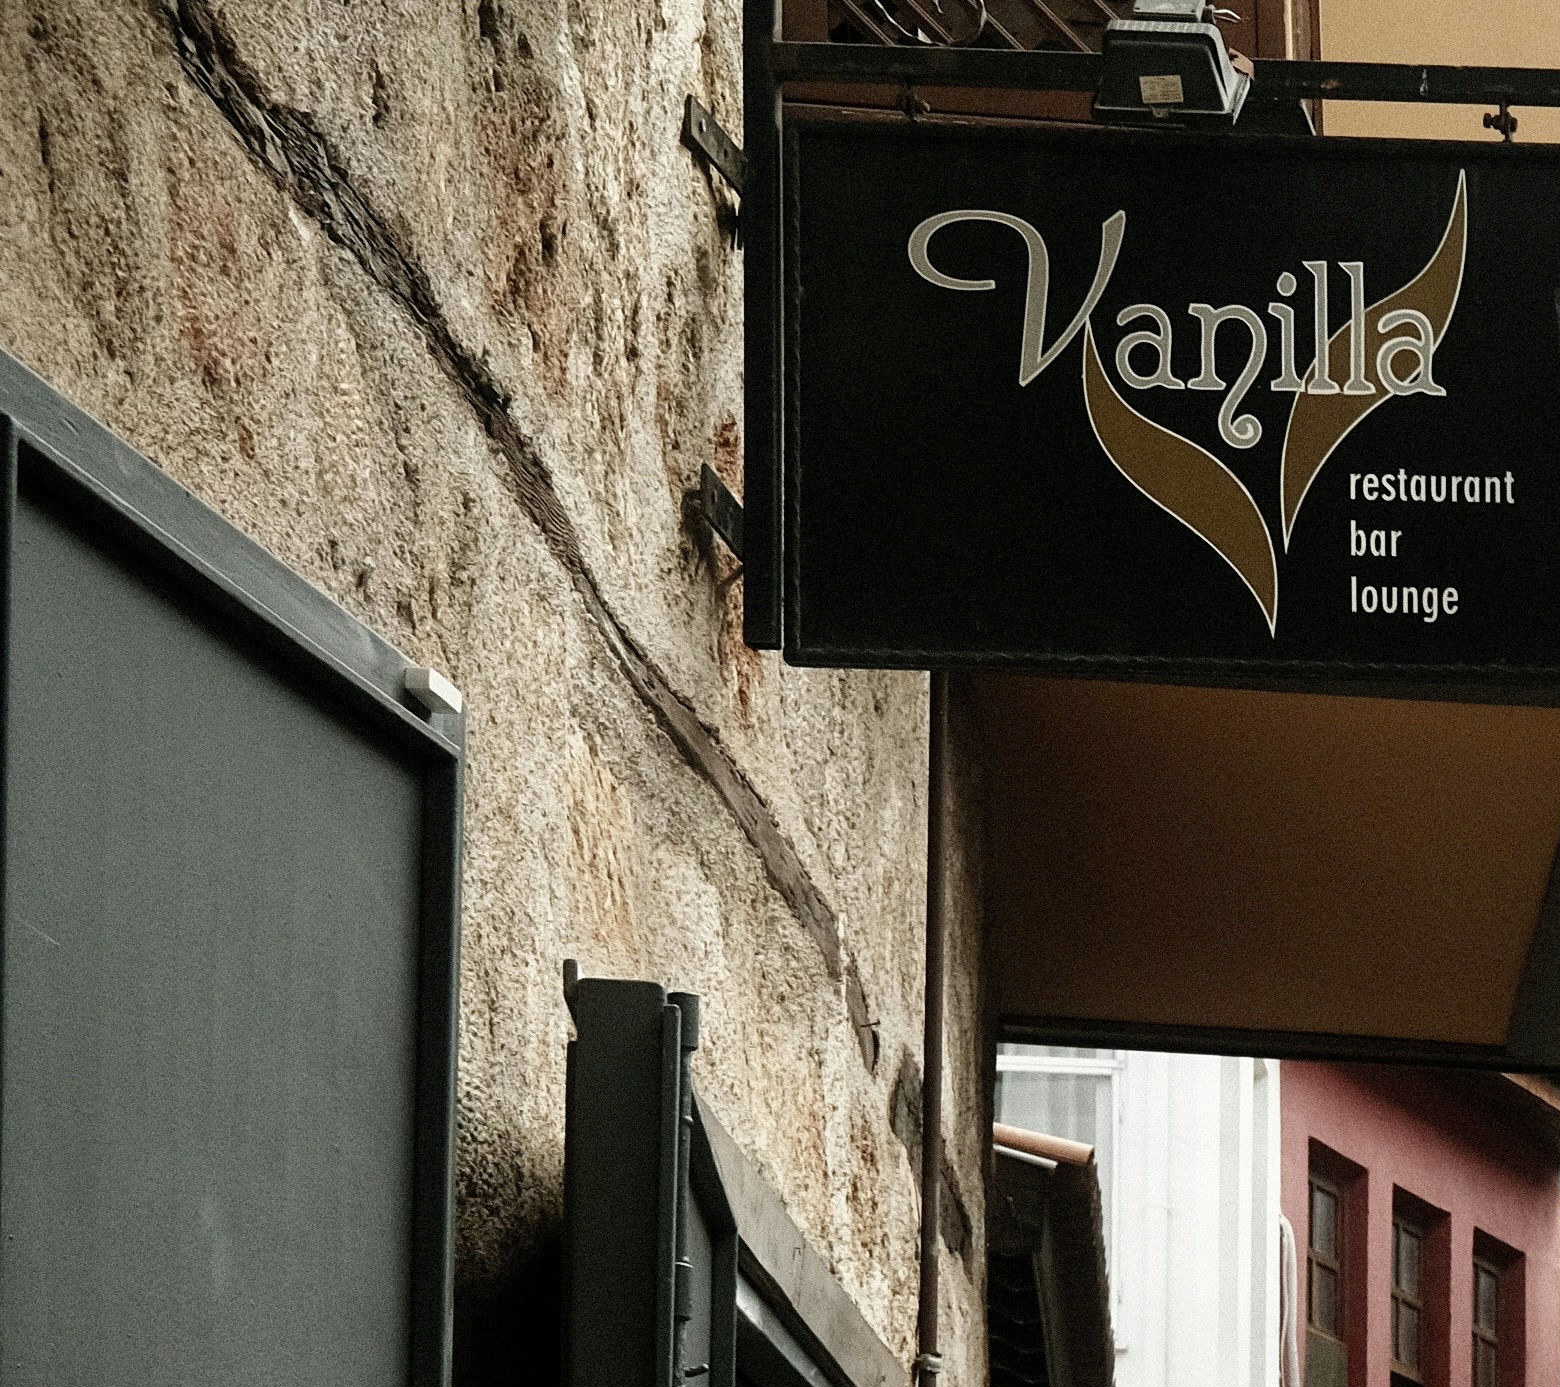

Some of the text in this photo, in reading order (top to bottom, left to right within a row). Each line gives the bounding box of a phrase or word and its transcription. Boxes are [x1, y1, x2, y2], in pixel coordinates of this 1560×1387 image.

[907, 208, 1447, 449] Vanilla
[1348, 468, 1516, 503] restaurant
[1348, 520, 1402, 558] bar
[1349, 576, 1460, 623] lounge
